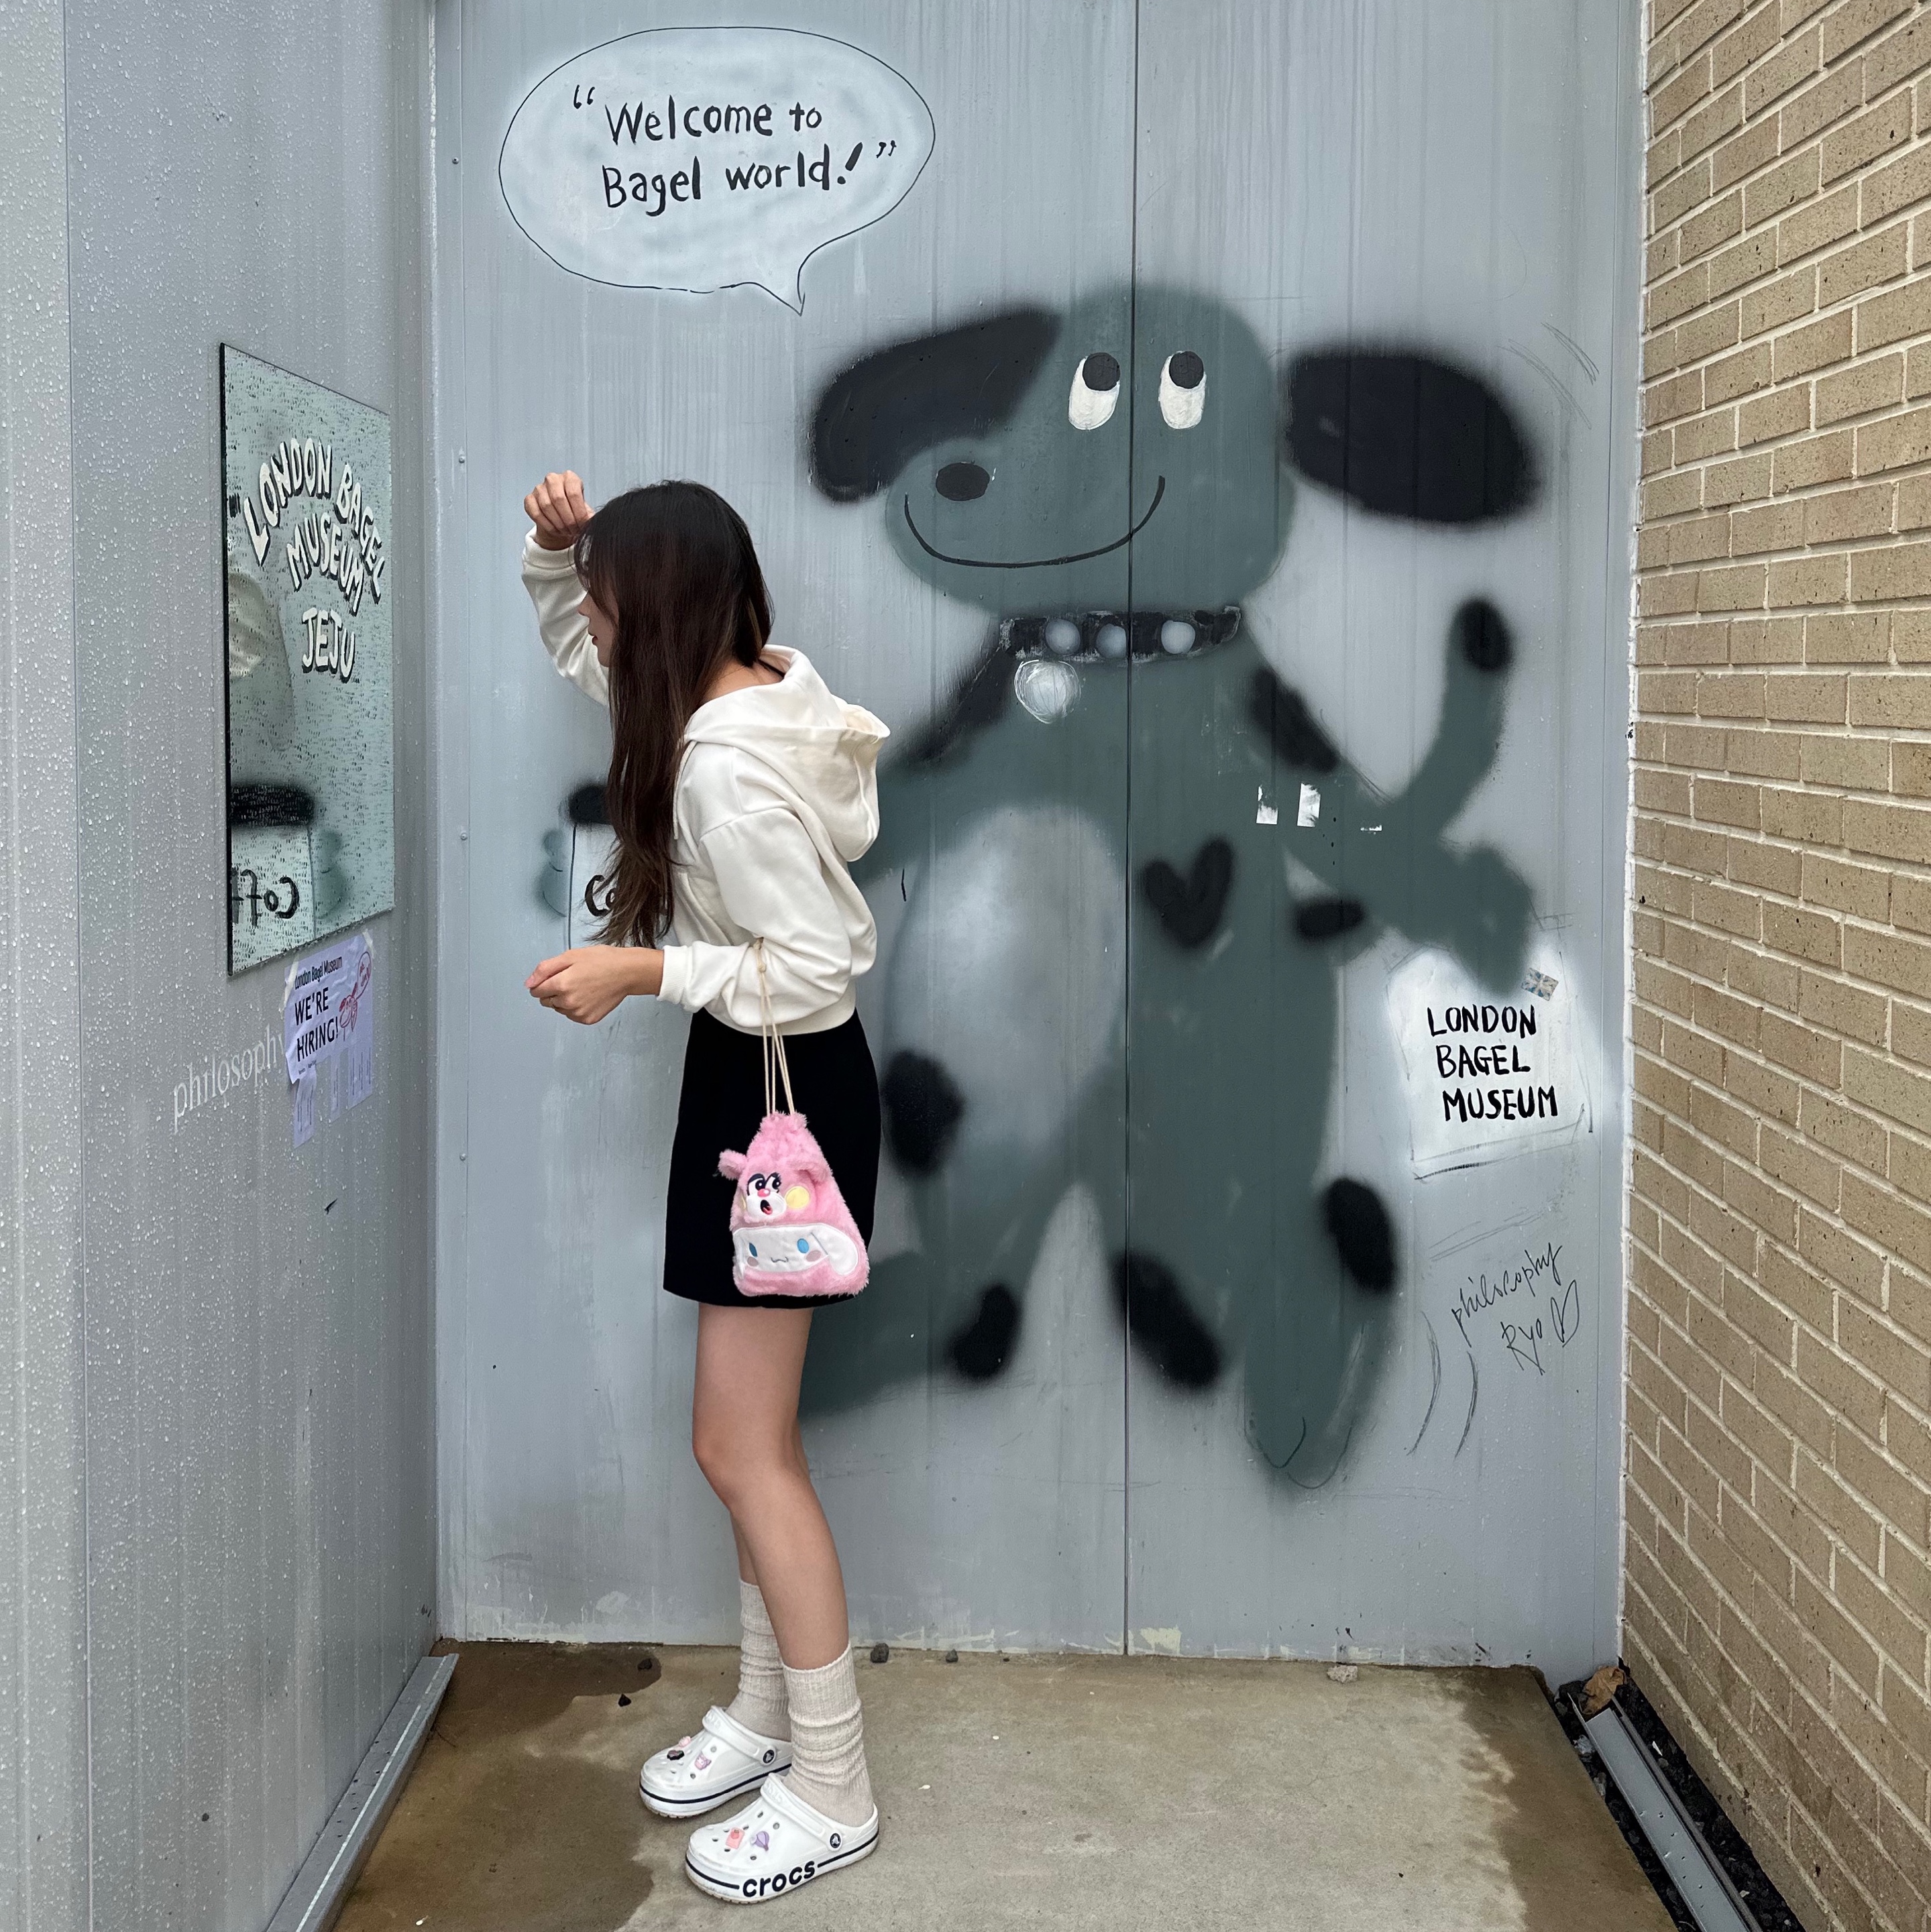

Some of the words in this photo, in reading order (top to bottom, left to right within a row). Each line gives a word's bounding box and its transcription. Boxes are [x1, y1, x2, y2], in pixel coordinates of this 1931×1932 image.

[789, 101, 822, 131] to
[602, 155, 702, 217] Bagel
[243, 437, 332, 567] LONDON
[335, 463, 385, 604] BAGEL
[286, 512, 366, 616] MUSEUM
[302, 606, 355, 683] JEJU
[294, 986, 329, 1026] WE'RE
[1427, 1004, 1537, 1039] LONDON
[296, 1016, 339, 1062] HIRING!
[1435, 1044, 1531, 1078] BAGEL
[1442, 1084, 1558, 1123] MUSEUM
[742, 1860, 816, 1897] crocs
